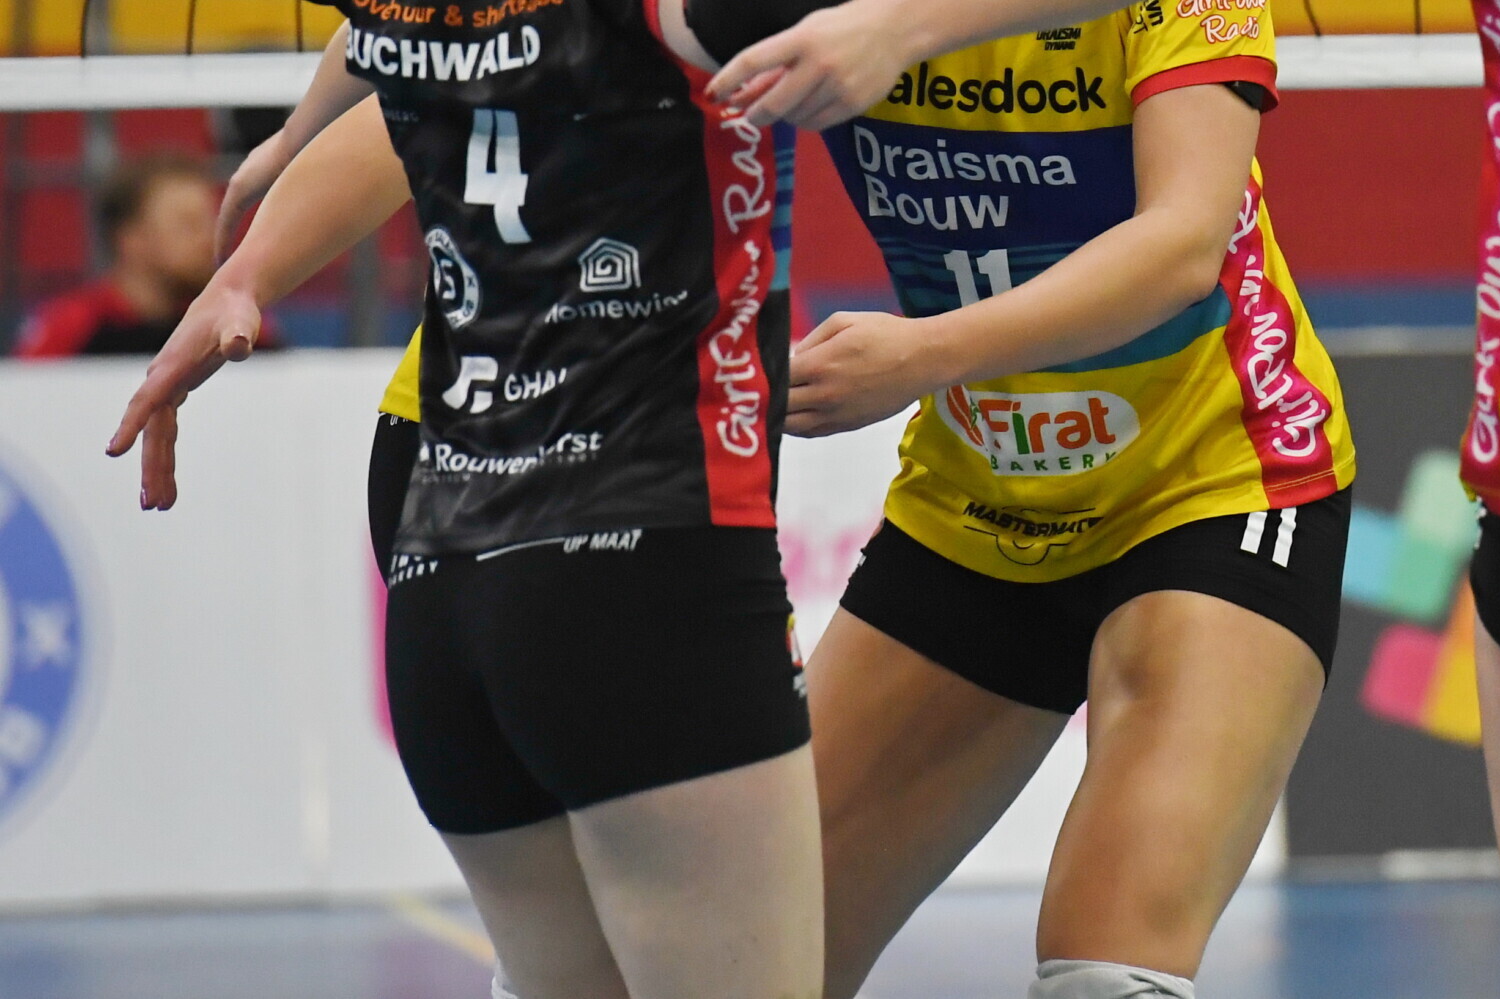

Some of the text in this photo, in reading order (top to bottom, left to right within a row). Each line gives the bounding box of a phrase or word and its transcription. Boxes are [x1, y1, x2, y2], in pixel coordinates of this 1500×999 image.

[887, 65, 1107, 115] alesdock
[463, 107, 533, 245] 4
[853, 124, 1078, 186] Draisma
[865, 171, 1010, 232] Bouw
[944, 248, 1015, 312] 11
[978, 397, 1117, 455] Firat
[990, 450, 1118, 472] BAKERY
[1239, 507, 1298, 568] 11
